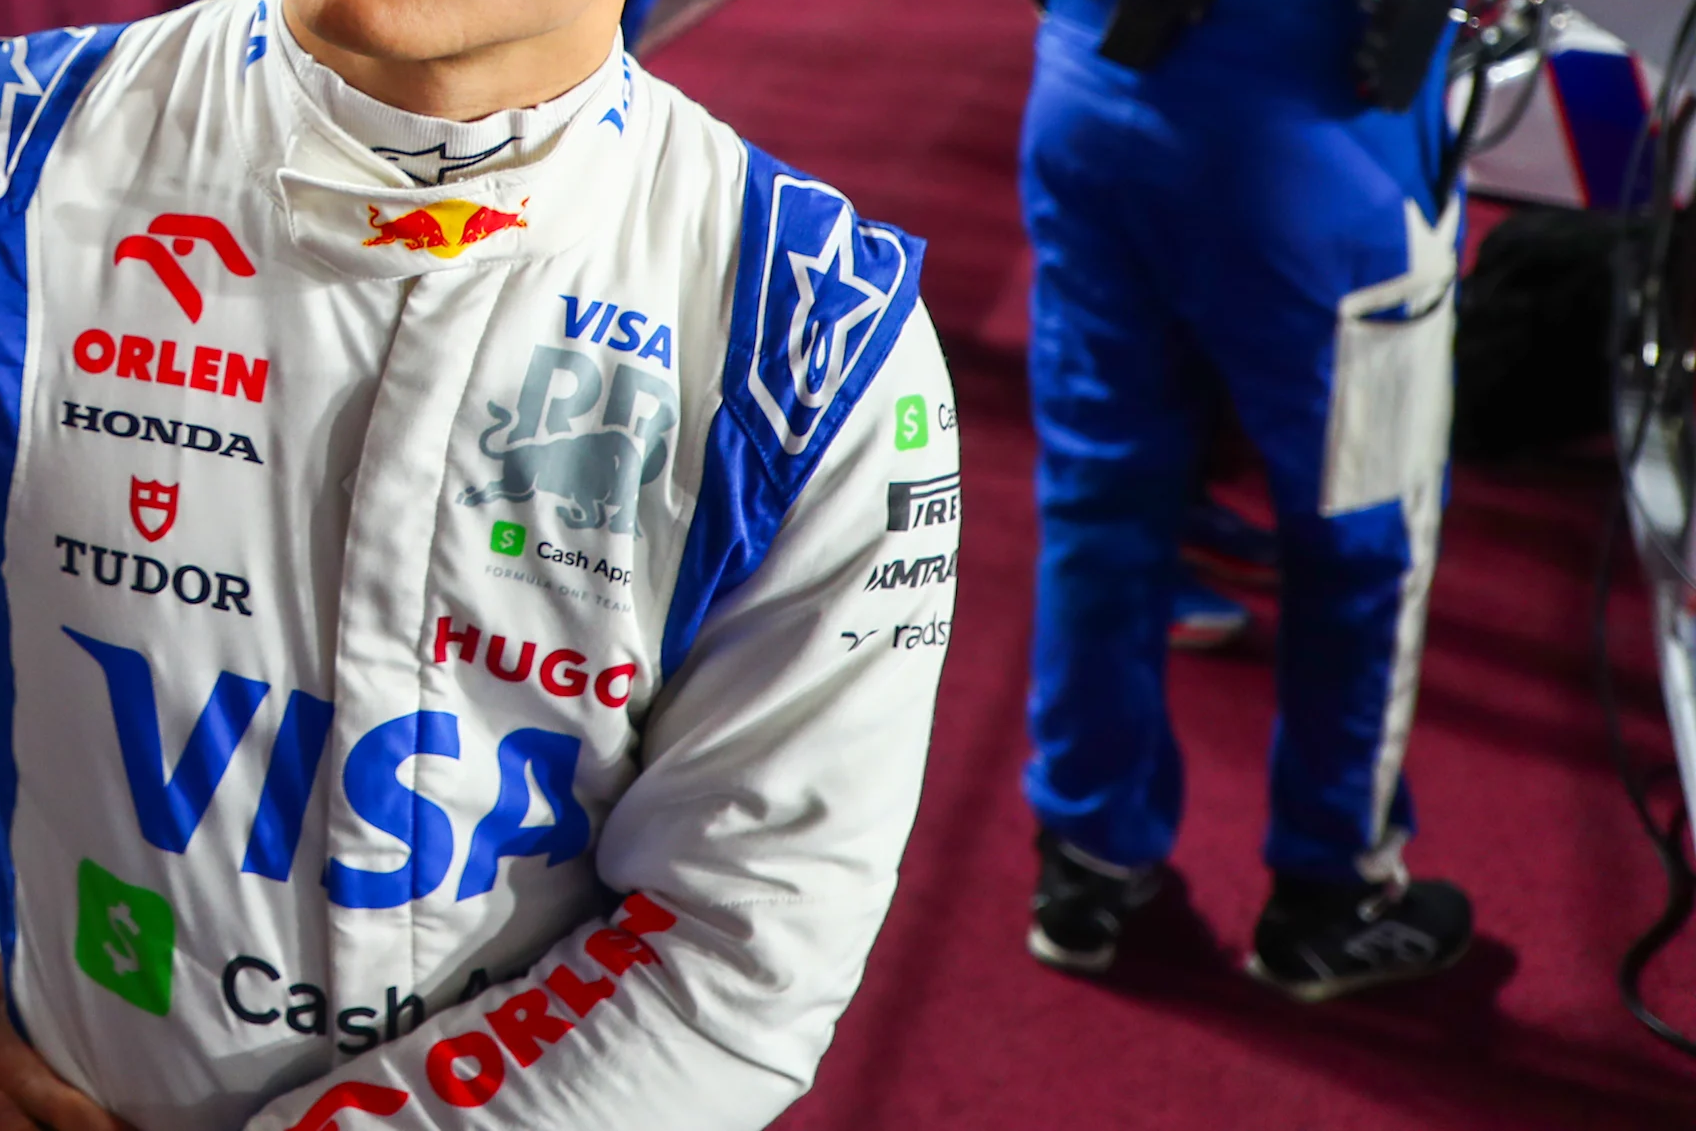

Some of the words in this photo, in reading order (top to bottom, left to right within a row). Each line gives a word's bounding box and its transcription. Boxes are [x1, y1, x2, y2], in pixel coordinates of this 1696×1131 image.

[72, 328, 269, 403] ORLEN
[558, 294, 672, 370] VISA
[61, 401, 264, 465] HONDA
[54, 535, 253, 616] TUDOR
[485, 564, 553, 590] FORMULA
[558, 585, 588, 601] ONE
[595, 595, 632, 613] TEAM
[536, 542, 590, 570] Cash
[593, 558, 633, 587] App
[434, 616, 637, 709] HUGO
[60, 624, 591, 910] VISA
[221, 954, 426, 1057] Cash
